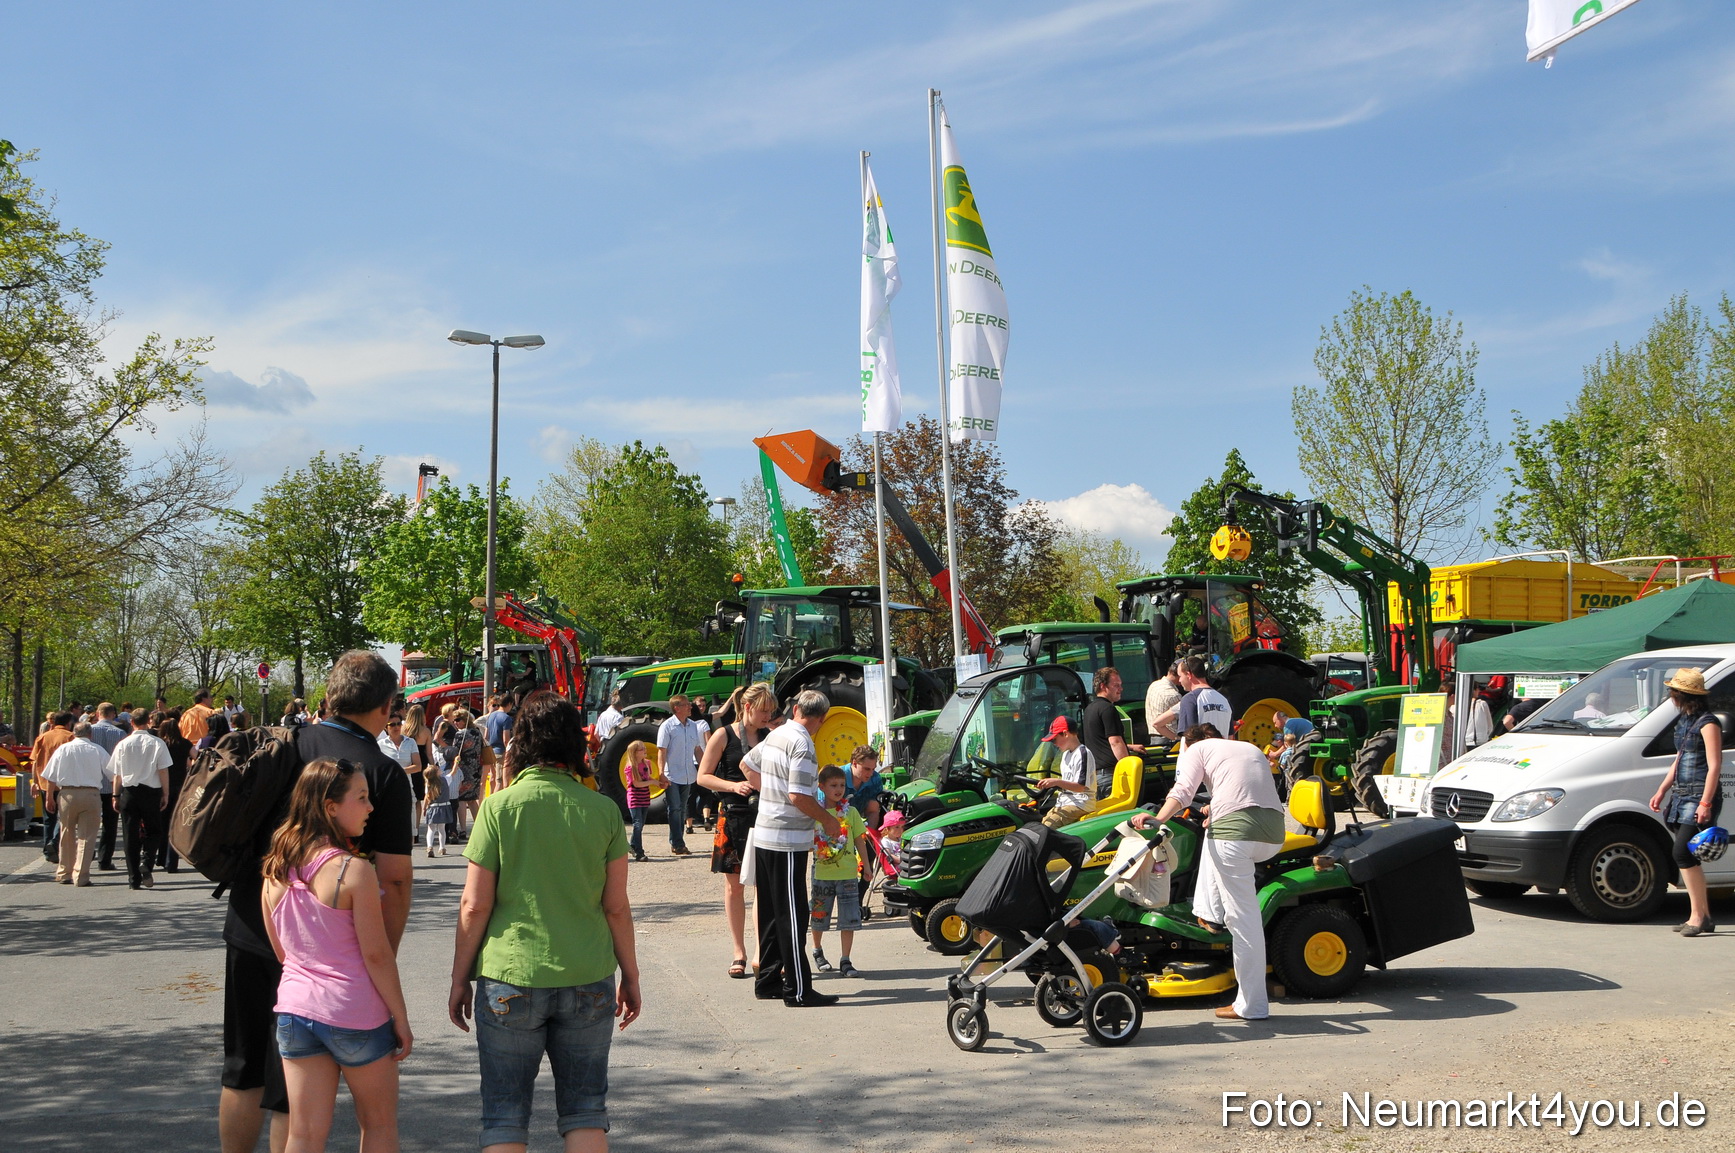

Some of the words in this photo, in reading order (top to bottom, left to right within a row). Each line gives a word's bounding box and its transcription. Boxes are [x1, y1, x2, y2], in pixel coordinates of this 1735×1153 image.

[960, 260, 1004, 292] DEER
[955, 310, 1008, 331] DEERE
[1580, 594, 1633, 608] TORRO
[967, 834, 985, 842] JOHN
[985, 829, 1008, 838] DEERE
[1093, 854, 1115, 863] JOHN
